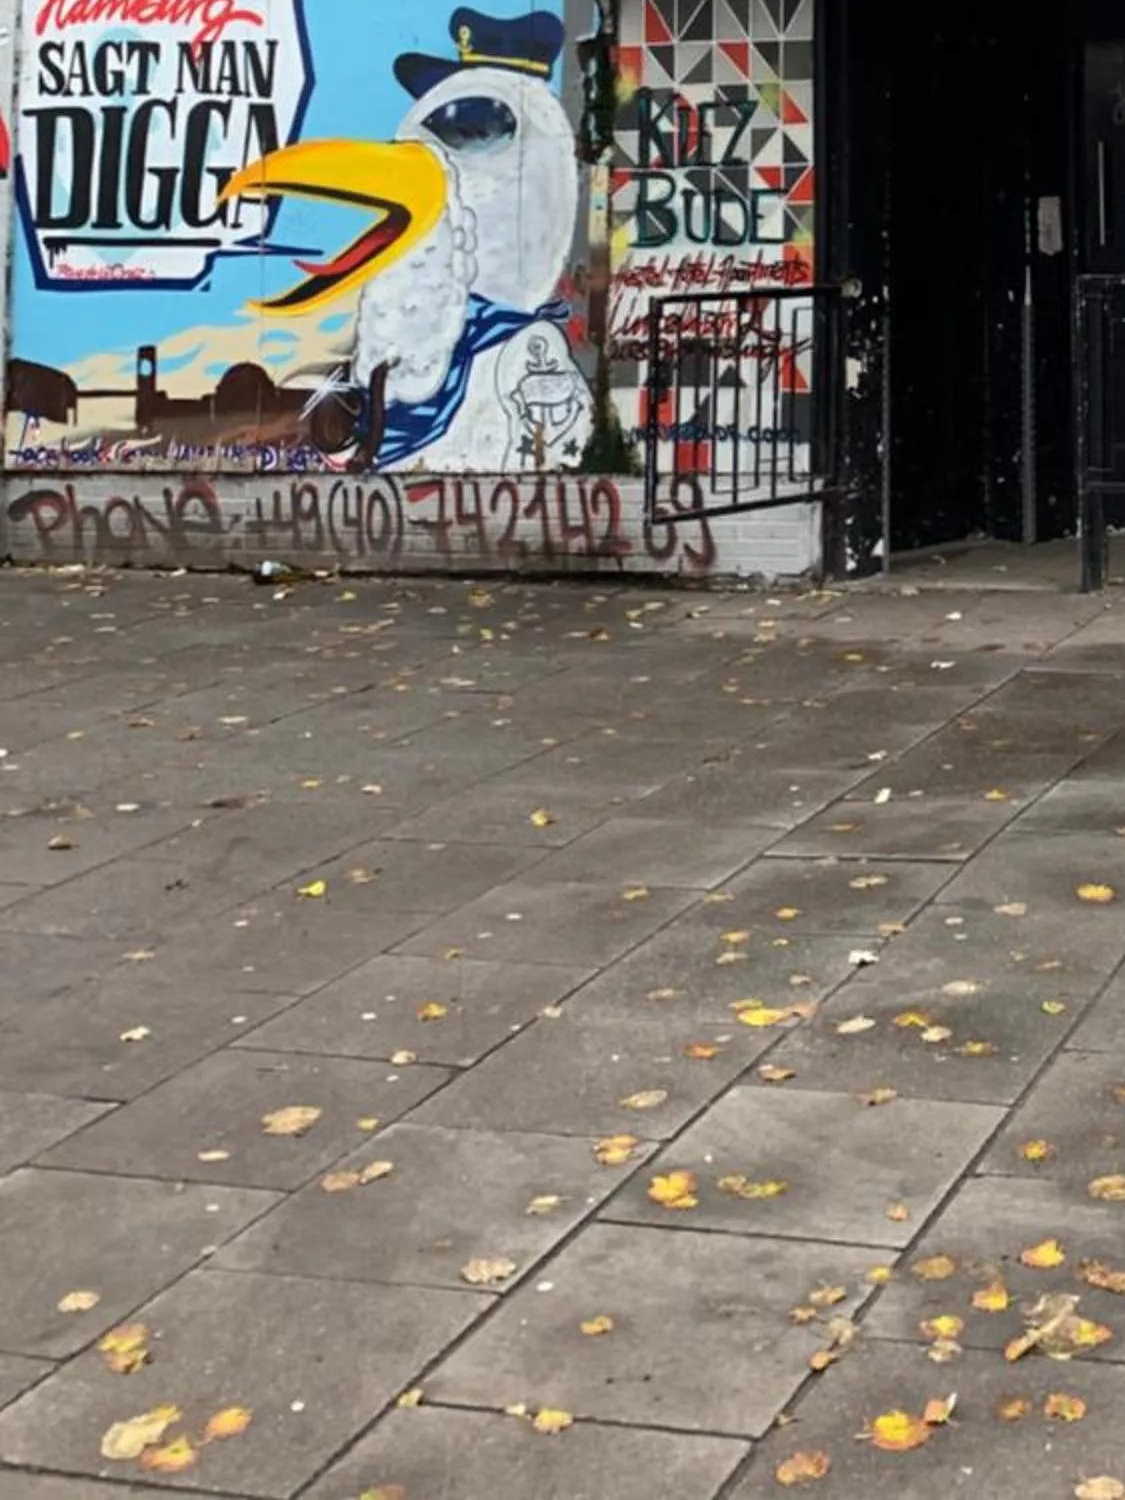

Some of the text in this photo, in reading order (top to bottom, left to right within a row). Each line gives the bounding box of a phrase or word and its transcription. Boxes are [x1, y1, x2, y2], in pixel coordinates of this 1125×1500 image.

[38, 38, 281, 99] SAGT MAN
[22, 96, 280, 232] DIGGA
[632, 86, 760, 168] KIEZ
[627, 169, 793, 249] BUDE
